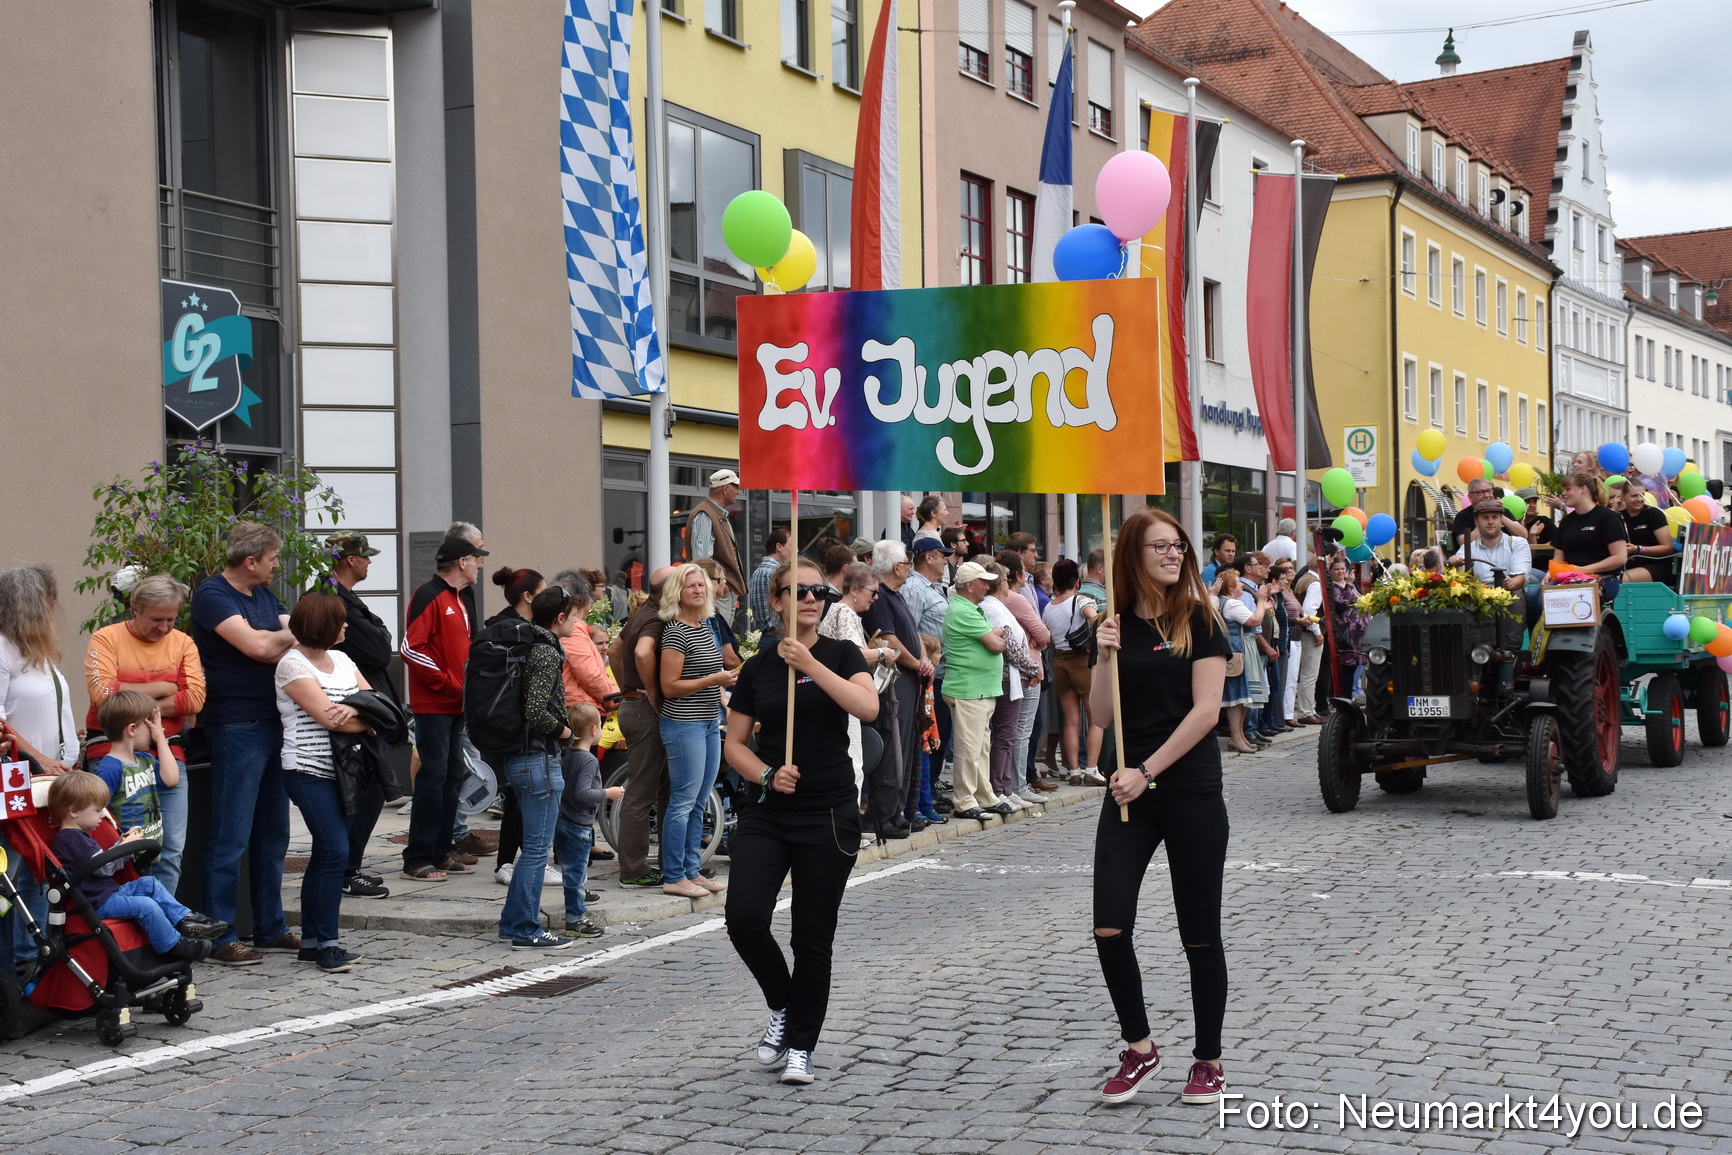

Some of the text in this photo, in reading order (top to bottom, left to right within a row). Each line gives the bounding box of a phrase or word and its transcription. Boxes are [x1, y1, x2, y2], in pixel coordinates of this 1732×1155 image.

[172, 313, 221, 393] G2
[756, 313, 1118, 476] Ev. Jugend
[1410, 707, 1416, 716] C
[1418, 707, 1442, 716] 1955
[1416, 698, 1429, 706] NM
